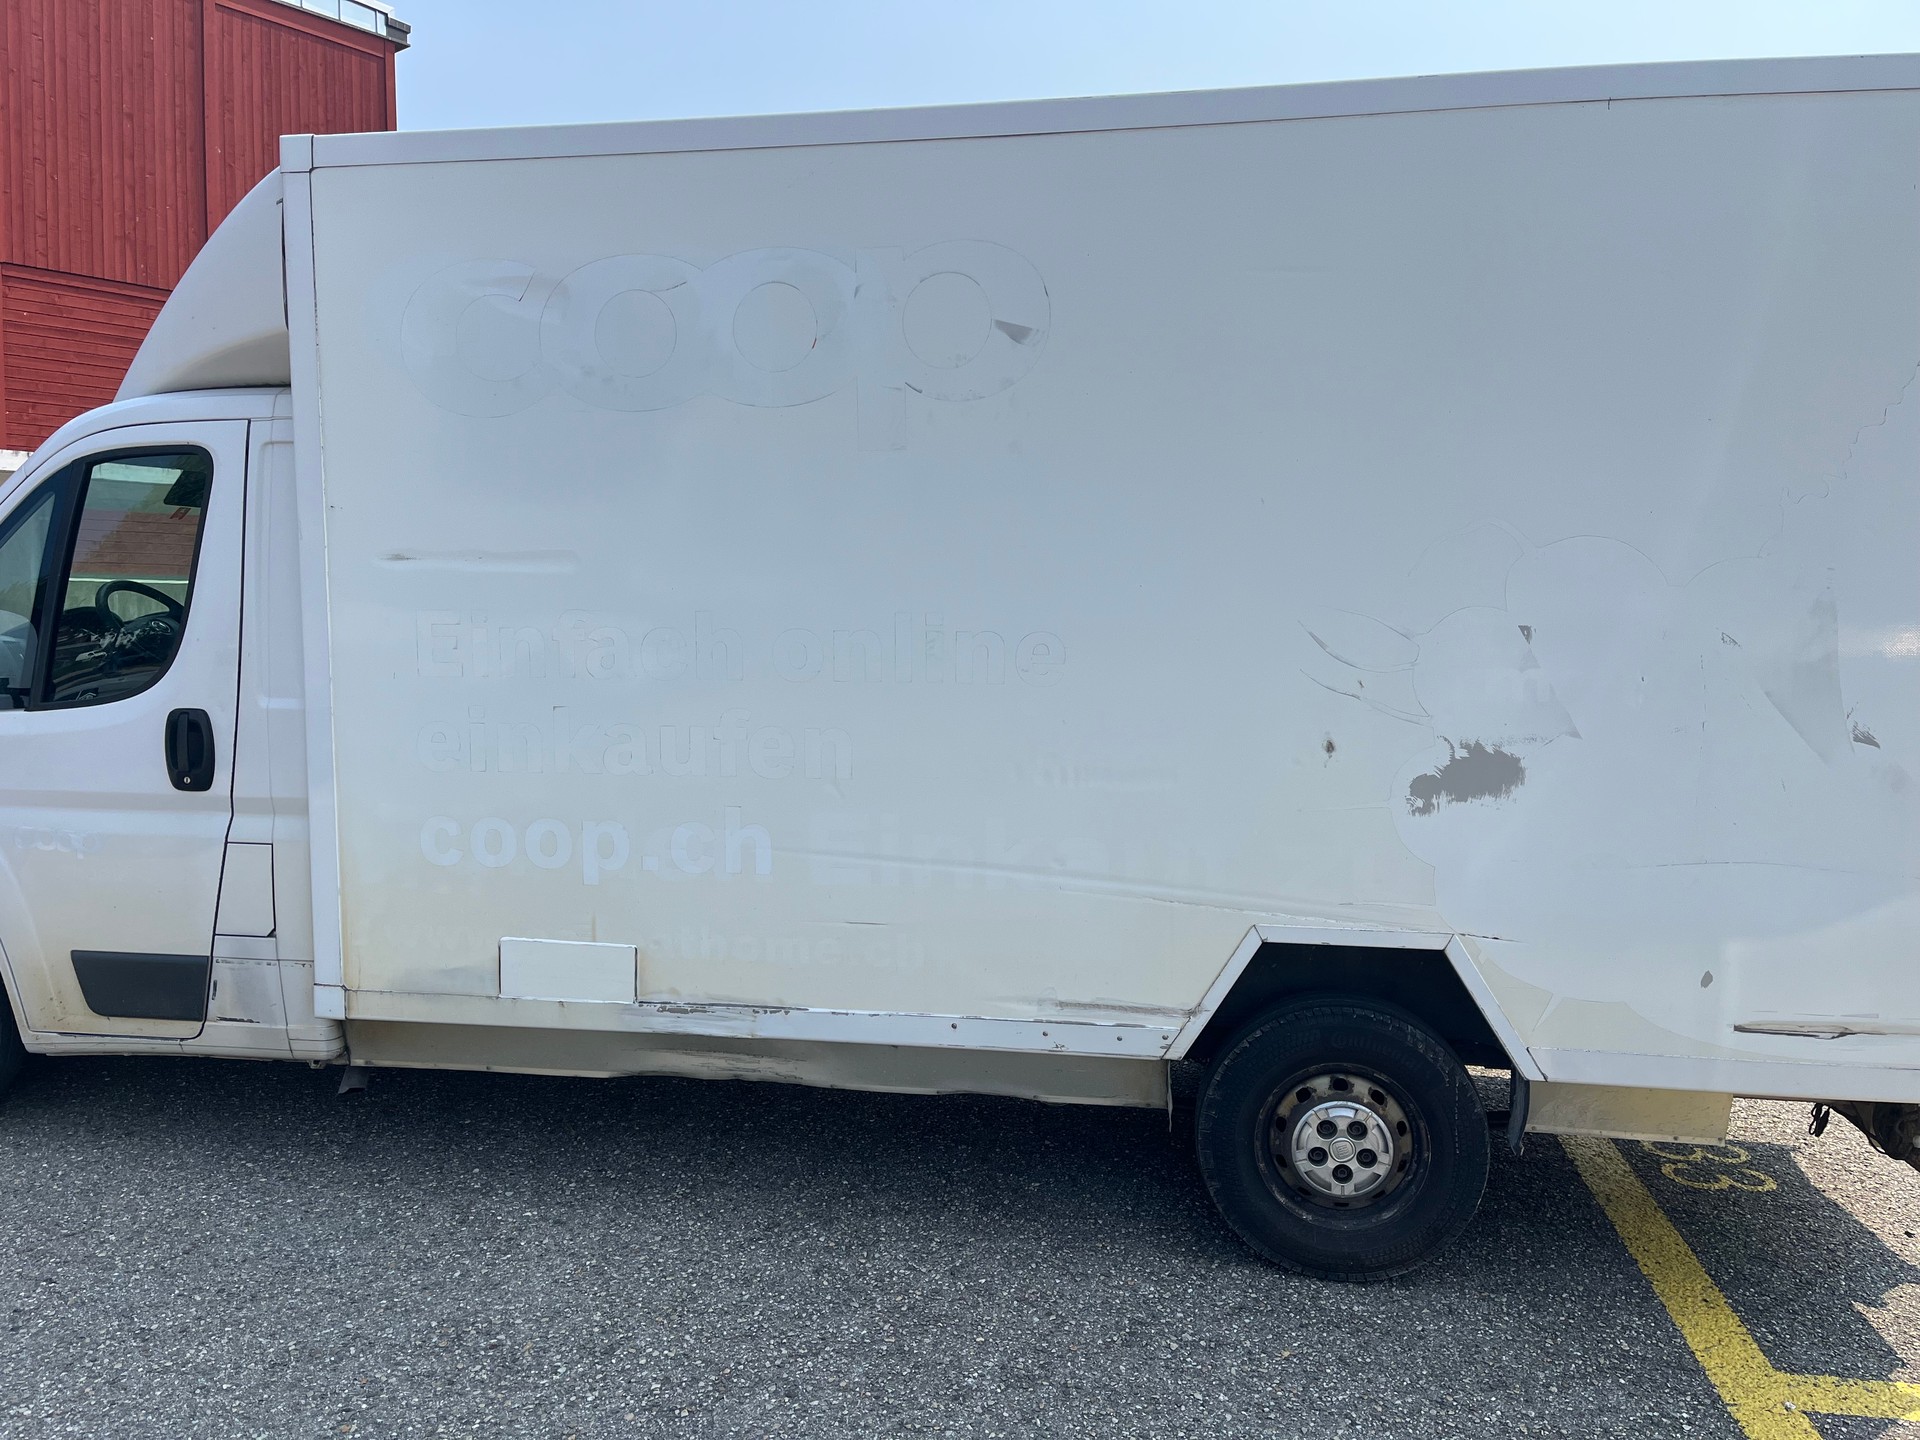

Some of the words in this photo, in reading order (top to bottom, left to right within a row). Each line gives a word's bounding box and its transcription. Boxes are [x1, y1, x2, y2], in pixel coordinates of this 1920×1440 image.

[400, 238, 1051, 452] coop
[416, 607, 743, 682] Einfach
[771, 609, 1067, 688] online
[415, 703, 854, 781] einkaufen
[420, 805, 772, 886] coop.ch
